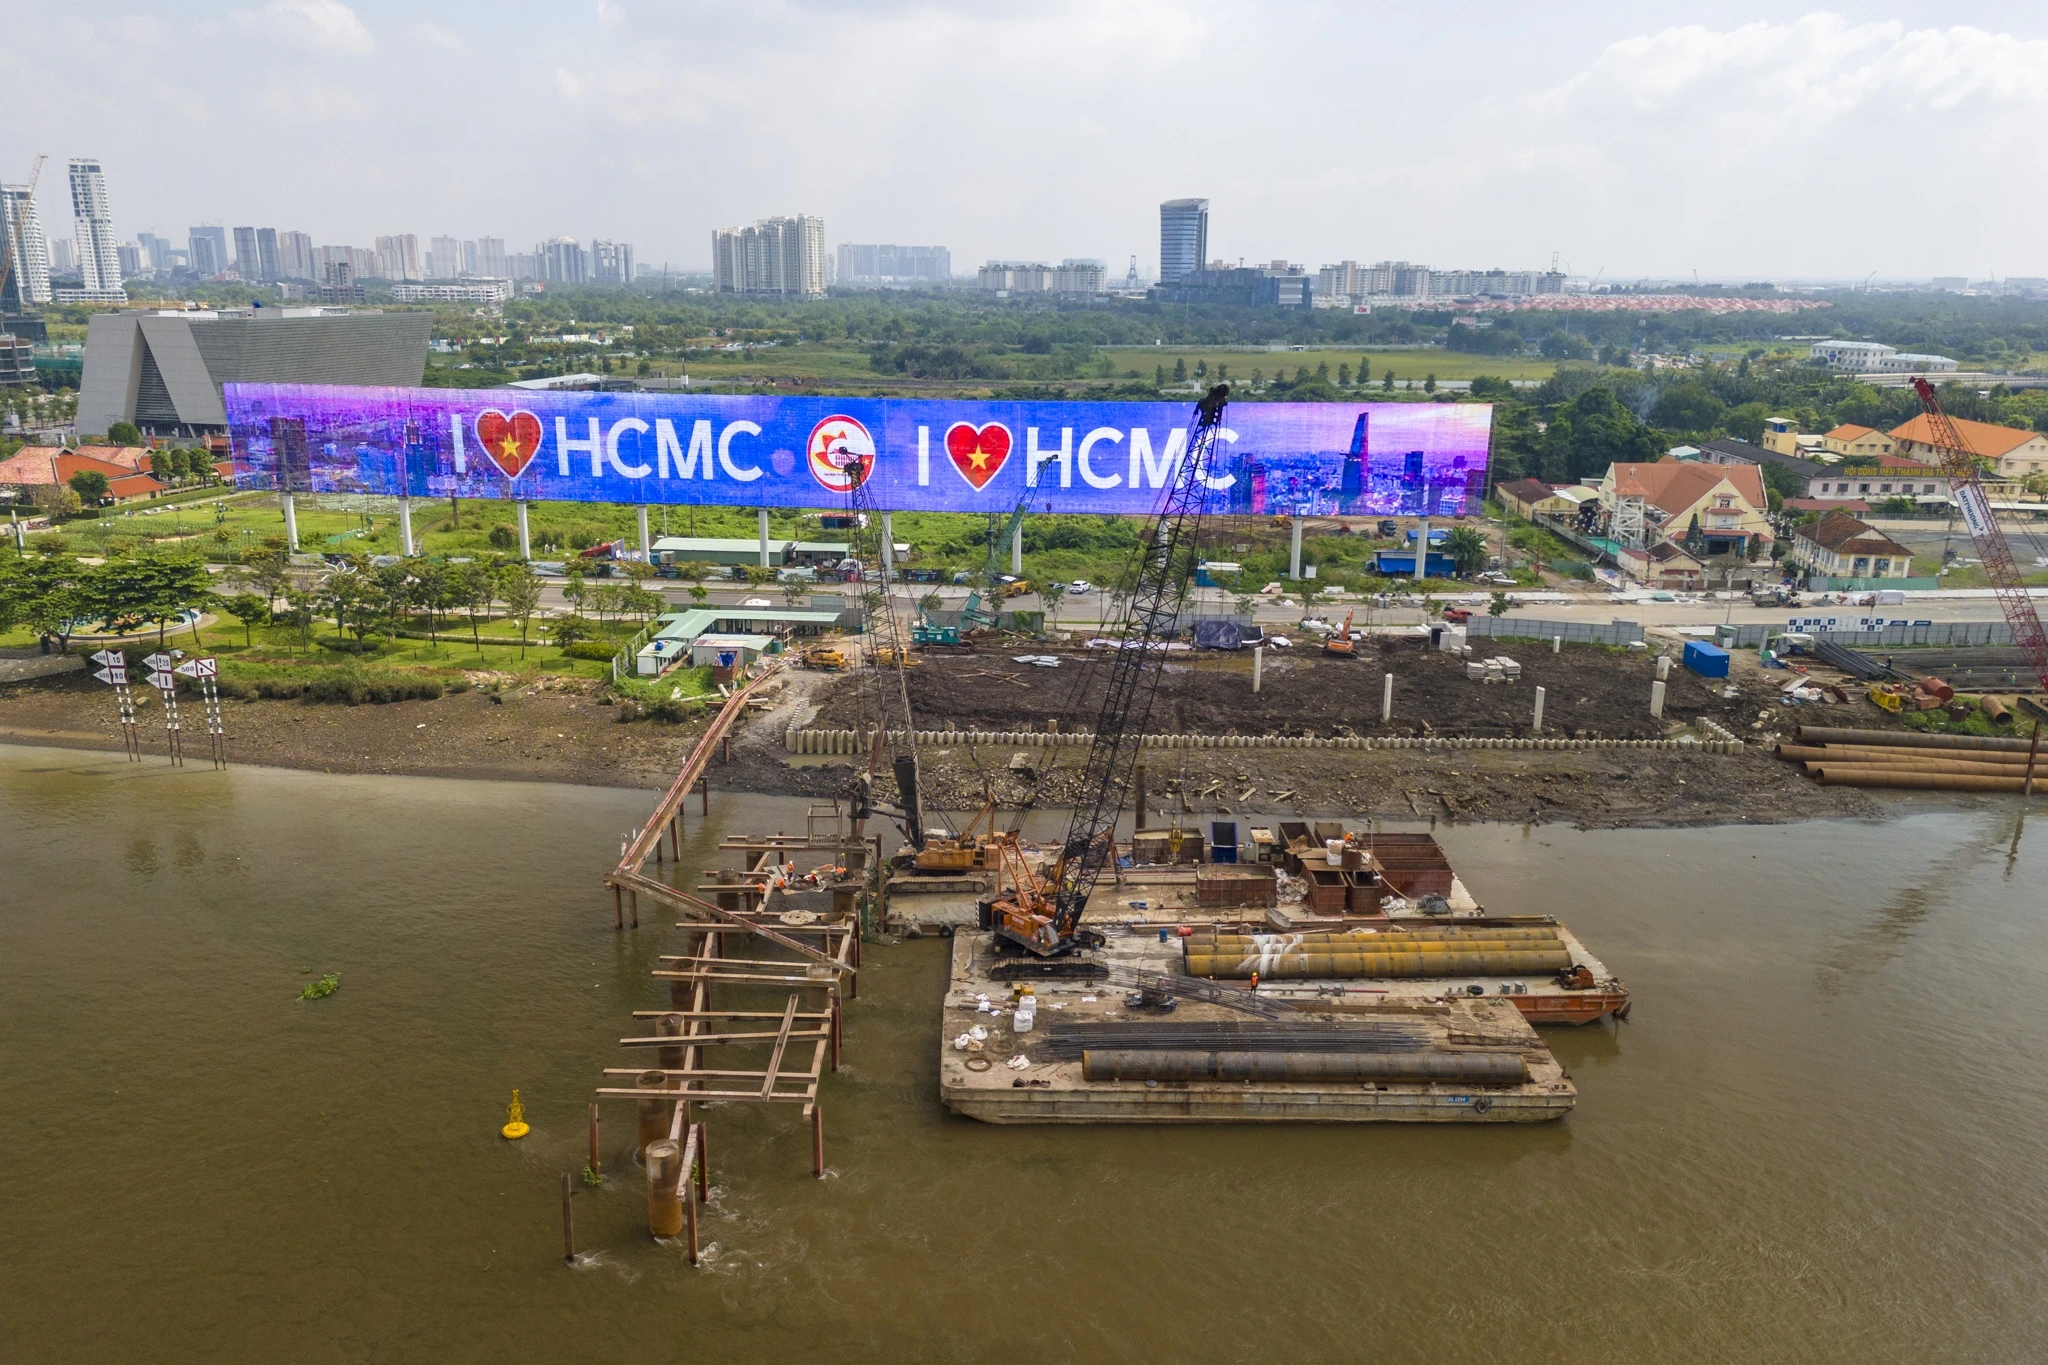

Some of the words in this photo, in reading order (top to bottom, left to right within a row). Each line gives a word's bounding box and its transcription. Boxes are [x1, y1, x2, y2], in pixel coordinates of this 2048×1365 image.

[451, 414, 466, 473] I
[555, 416, 764, 482] HCMC
[918, 425, 929, 486] I
[1026, 427, 1240, 490] HCMC
